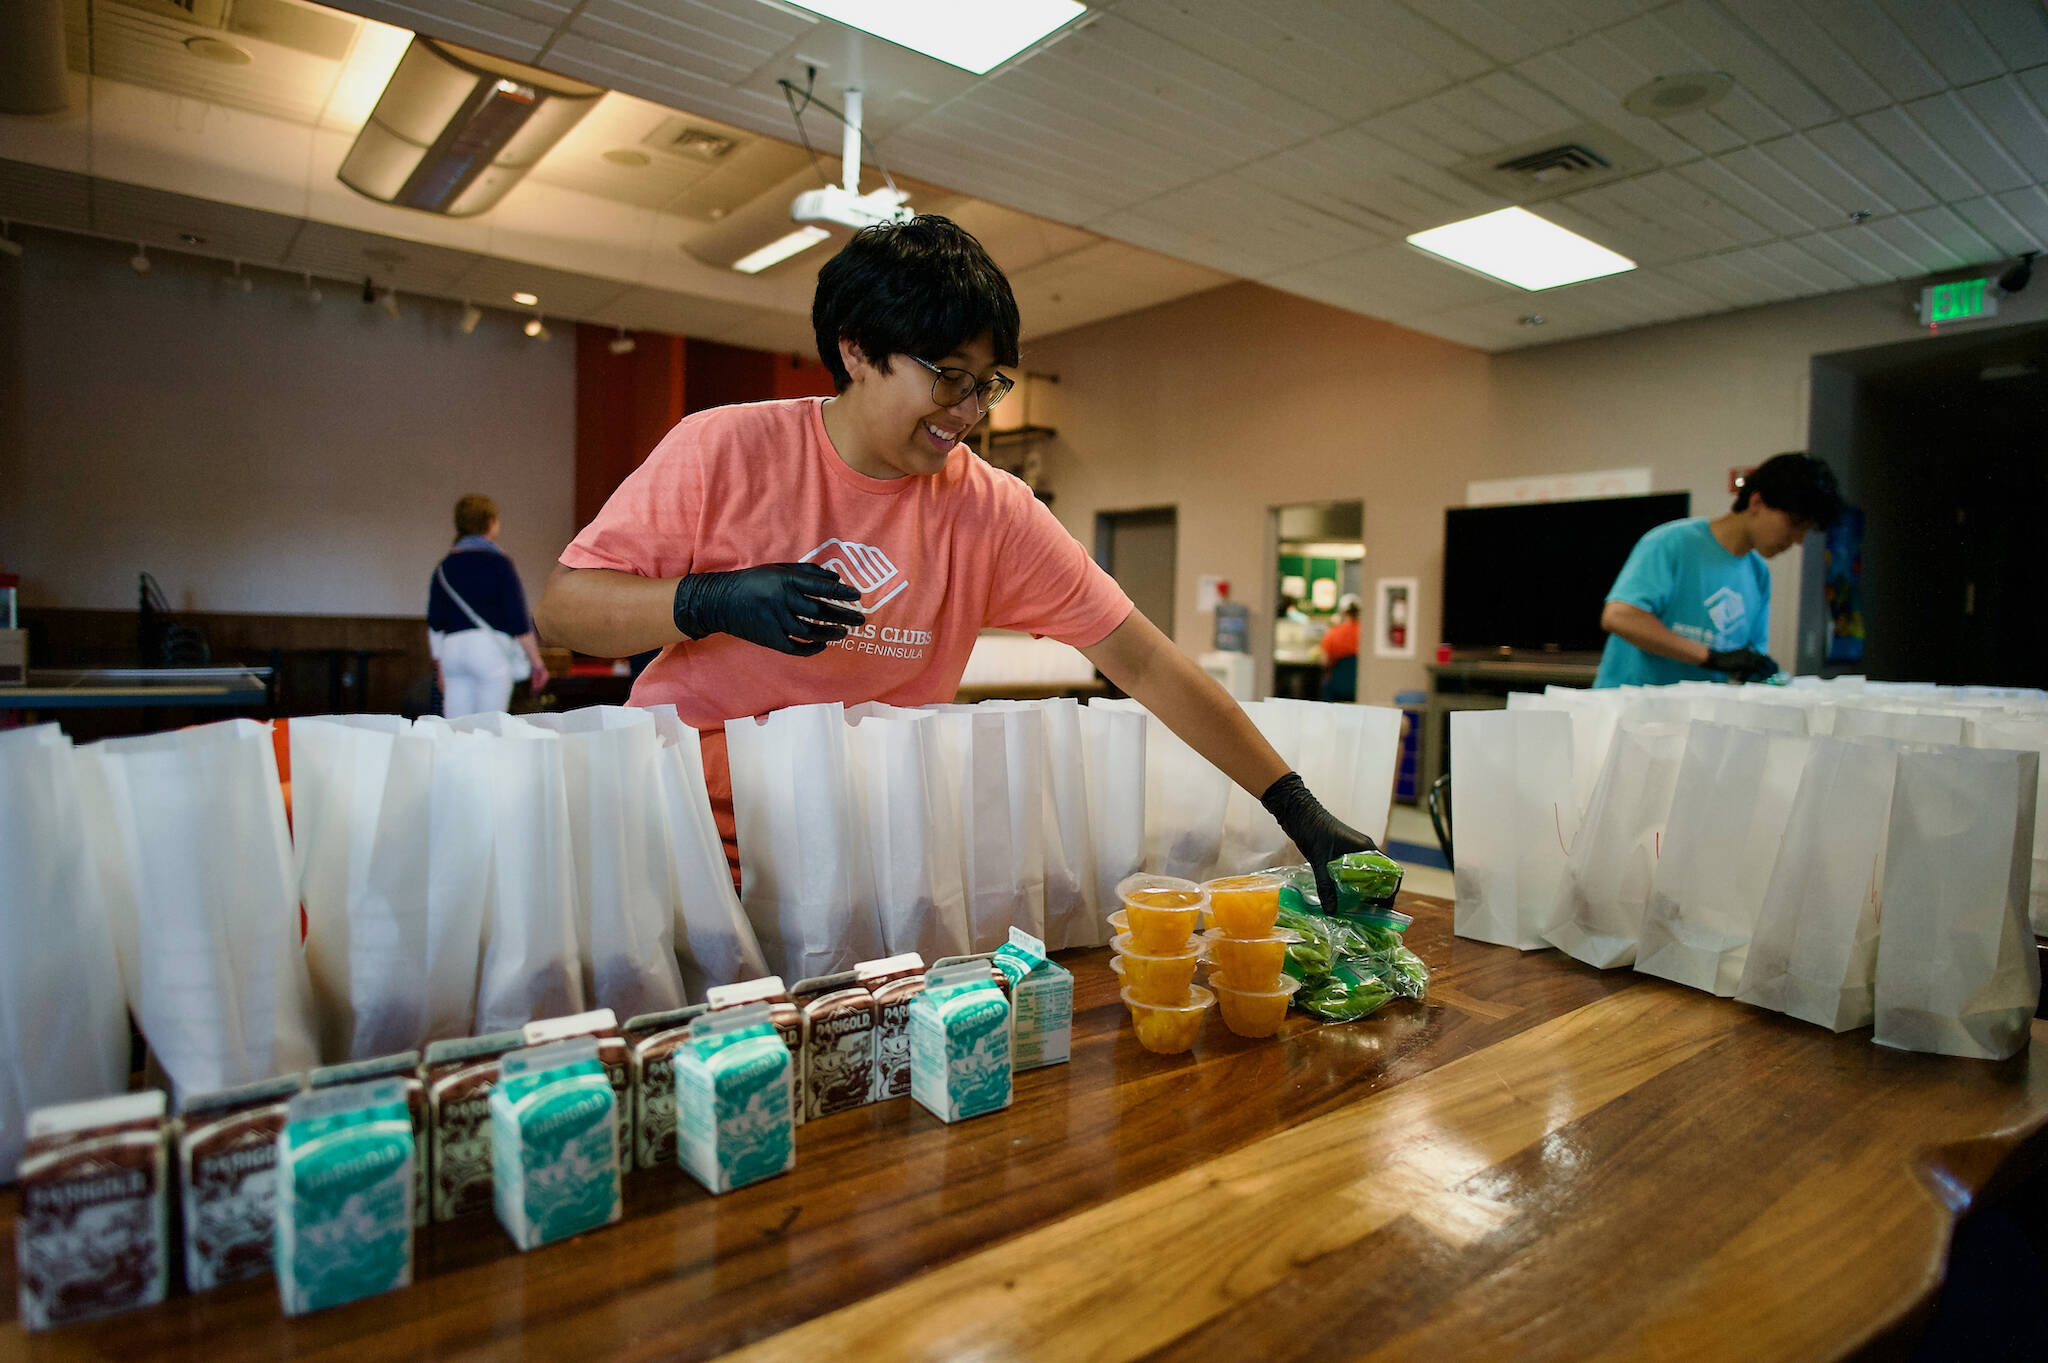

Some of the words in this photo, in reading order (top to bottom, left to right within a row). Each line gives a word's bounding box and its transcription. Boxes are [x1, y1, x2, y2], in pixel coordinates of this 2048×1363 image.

[1932, 277, 1988, 321] EXIT
[880, 627, 932, 645] CLUBS
[857, 642, 923, 659] PENINSULA
[816, 1013, 870, 1036] DARIGOLD
[952, 1004, 1003, 1036] DARIGOLD
